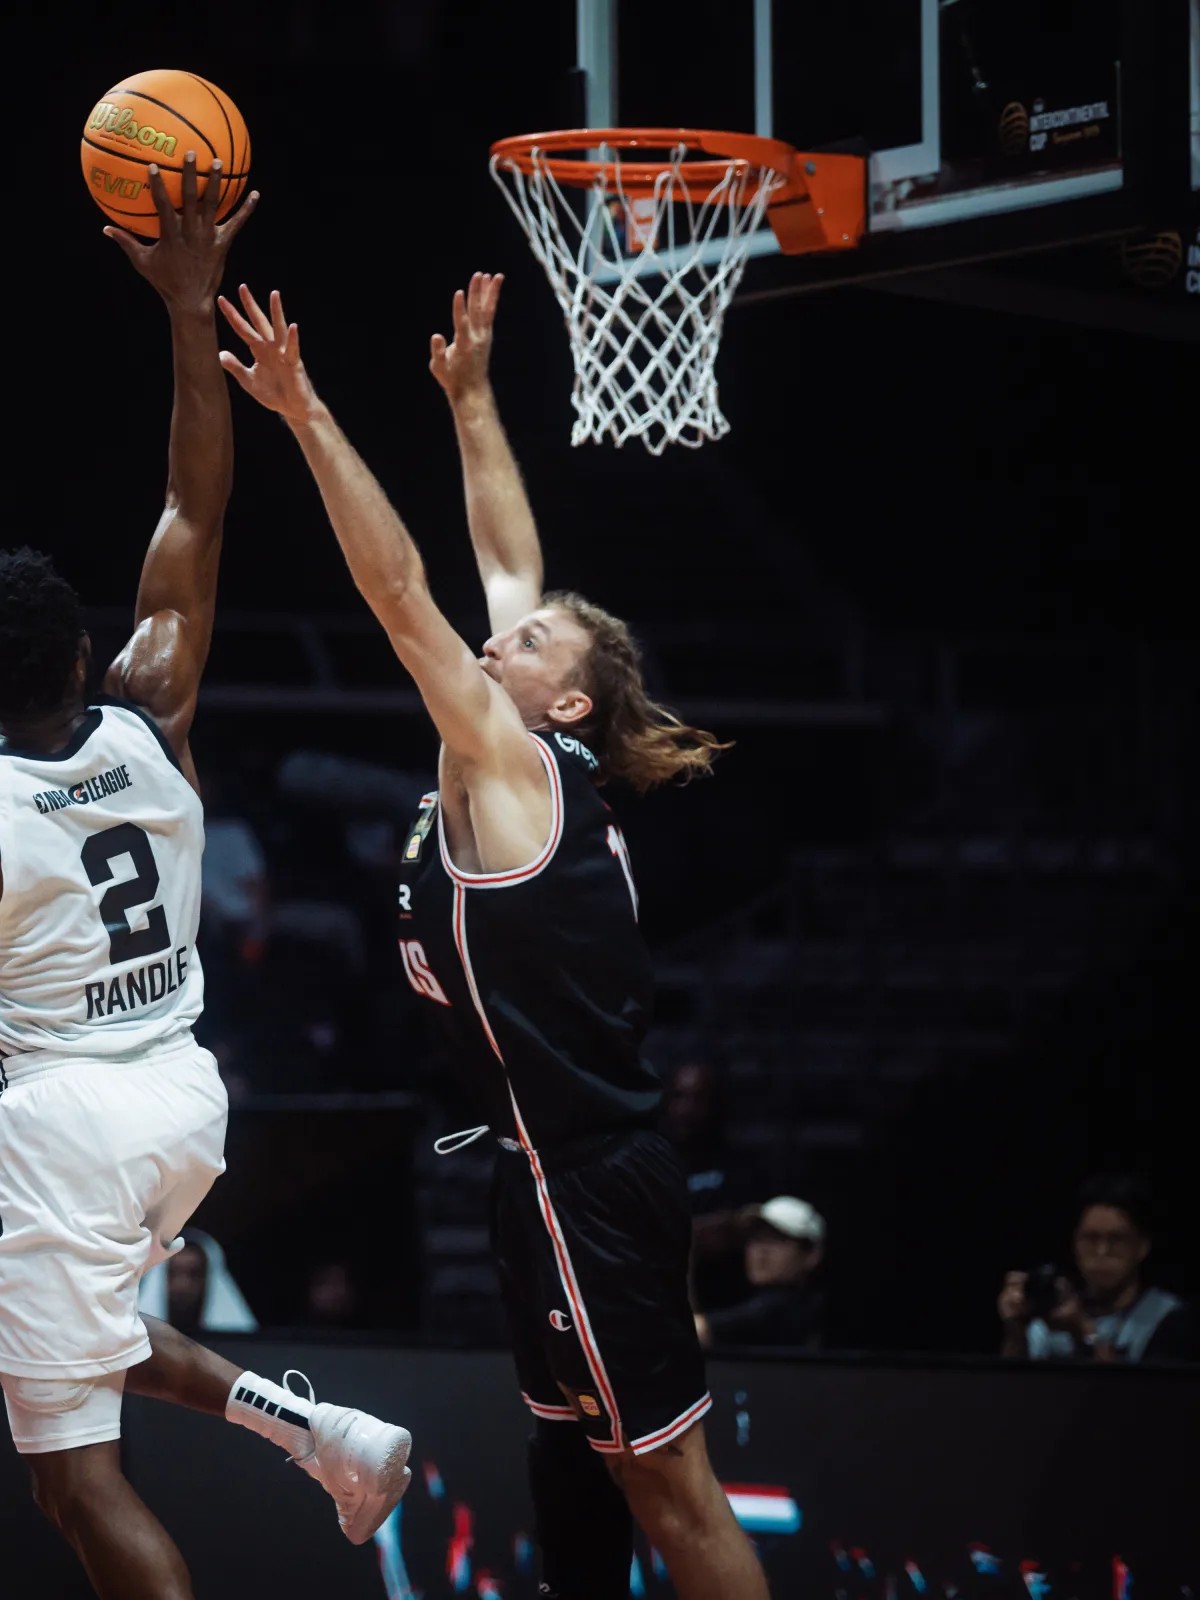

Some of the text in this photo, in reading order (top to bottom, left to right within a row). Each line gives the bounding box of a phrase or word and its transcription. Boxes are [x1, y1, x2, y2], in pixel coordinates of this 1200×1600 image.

[89, 102, 177, 157] Wilson
[1029, 131, 1048, 152] CUP
[90, 166, 143, 200] EVO
[43, 764, 133, 812] NBA G LEAGUE
[81, 821, 172, 966] 2
[85, 945, 188, 1020] RANDLE
